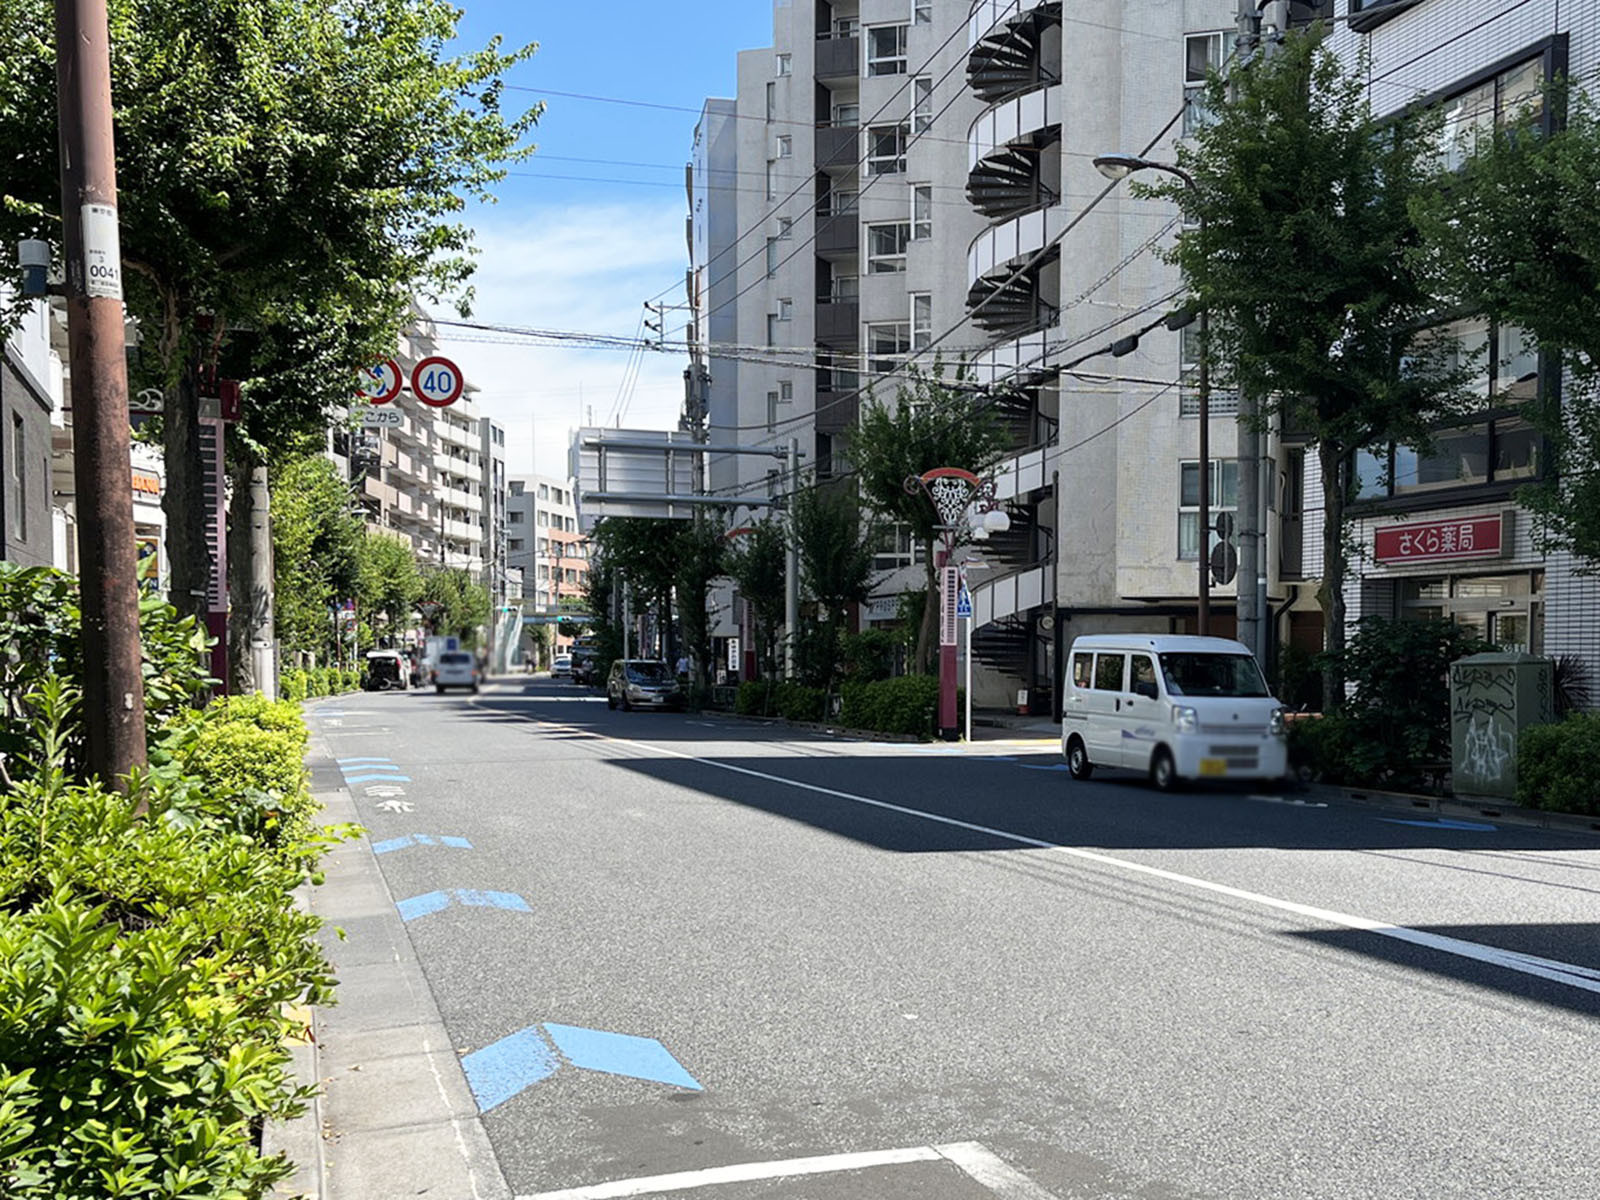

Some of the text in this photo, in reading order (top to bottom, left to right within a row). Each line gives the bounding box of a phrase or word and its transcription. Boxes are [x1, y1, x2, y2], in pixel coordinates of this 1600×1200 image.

[90, 265, 118, 281] 0041
[423, 371, 451, 393] 40
[354, 411, 400, 423] こから
[1399, 525, 1474, 555] さくら薬局
